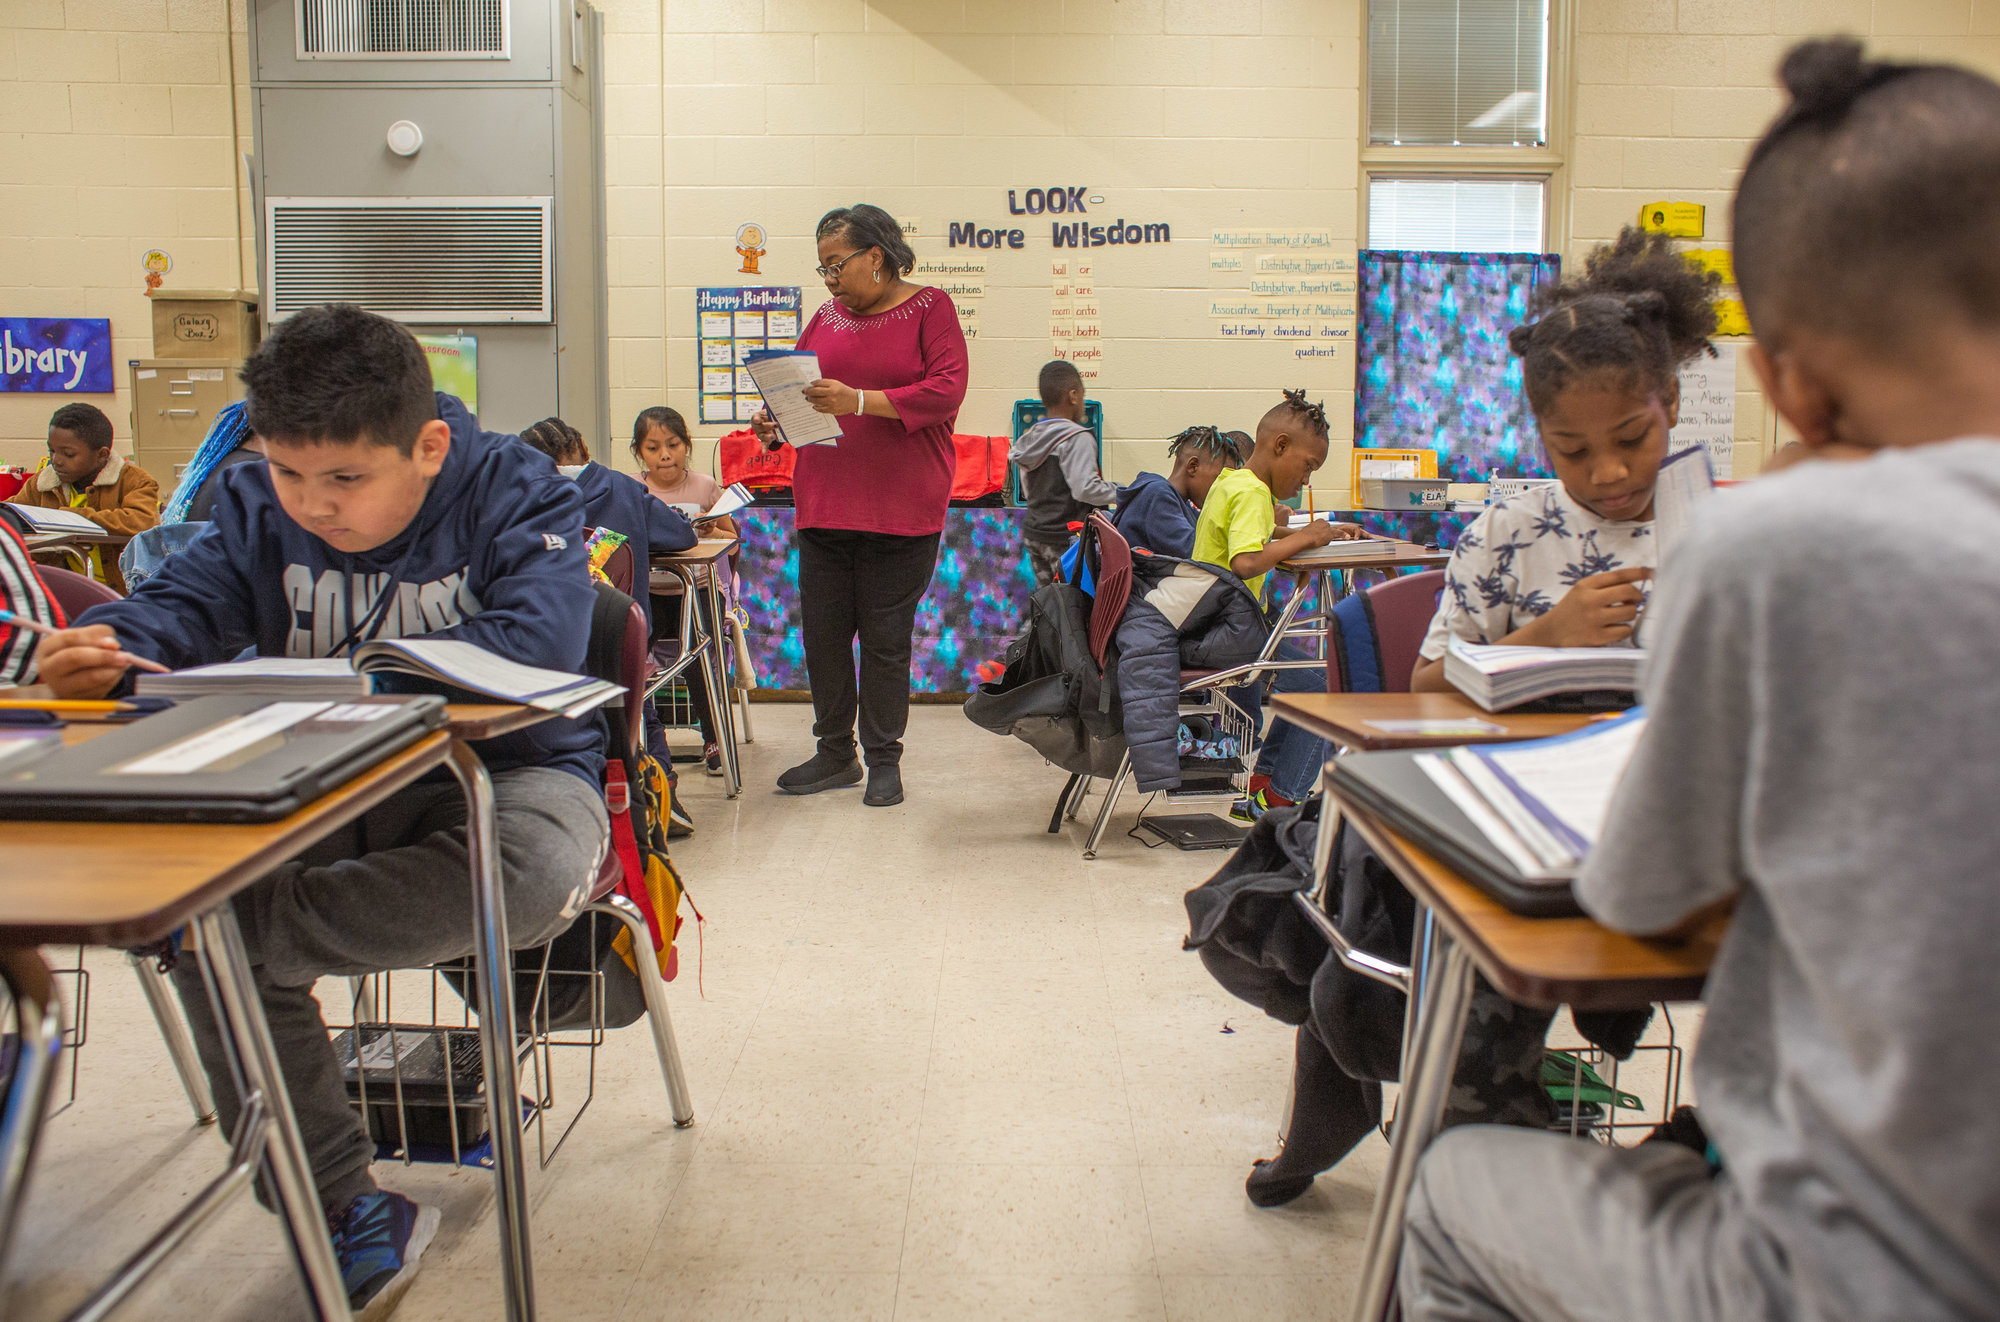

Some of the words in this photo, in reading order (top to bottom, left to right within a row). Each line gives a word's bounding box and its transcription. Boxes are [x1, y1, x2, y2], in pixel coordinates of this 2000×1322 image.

[1008, 186, 1088, 215] LOOK
[900, 222, 918, 233] ate
[949, 222, 1025, 249] More
[1052, 218, 1171, 248] Wisdom
[1213, 233, 1262, 247] Multiplication
[918, 262, 985, 274] interdependence
[1052, 264, 1067, 275] ball
[1079, 266, 1091, 274] or
[941, 283, 981, 295] aptations
[1055, 284, 1069, 296] call
[1075, 287, 1093, 295] are
[701, 290, 742, 309] Happy
[743, 289, 799, 309] Birthday
[957, 305, 976, 317] lage
[1076, 304, 1097, 316] onto
[1211, 303, 1260, 315] Associative
[1302, 303, 1311, 315] of
[962, 326, 978, 337] sity
[1052, 325, 1072, 337] there
[1076, 325, 1100, 337] both
[1221, 324, 1238, 336] fact
[1240, 324, 1266, 338] family
[1273, 325, 1311, 337] dividend
[1320, 325, 1350, 337] divisor
[1054, 346, 1067, 360] by
[1072, 346, 1102, 360] people
[1295, 345, 1336, 359] quotient
[1080, 370, 1098, 378] saw
[746, 453, 782, 469] Caleb
